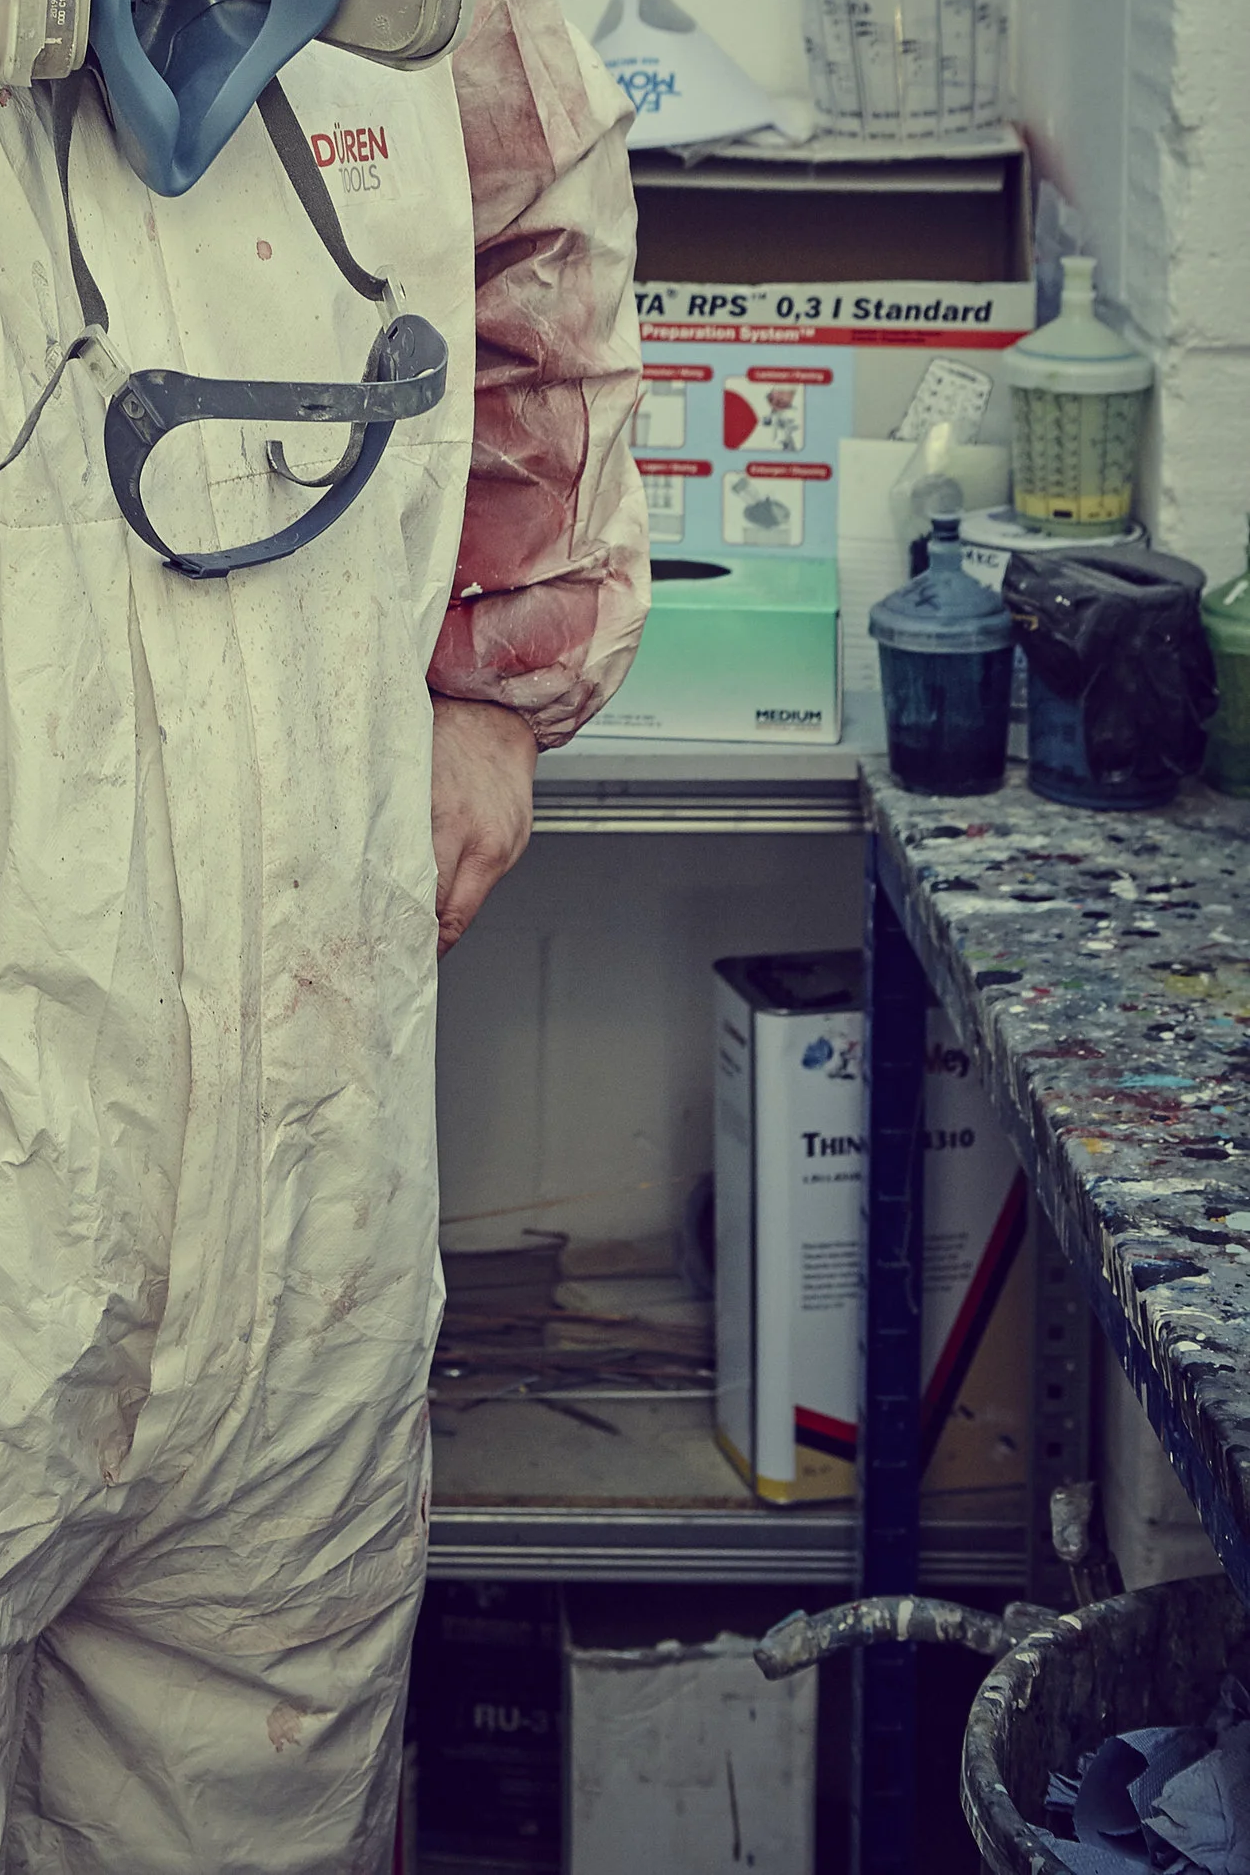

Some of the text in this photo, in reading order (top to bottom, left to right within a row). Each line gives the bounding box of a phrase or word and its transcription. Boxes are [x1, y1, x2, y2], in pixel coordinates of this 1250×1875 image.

[310, 122, 389, 168] DÜREN
[338, 164, 381, 193] TOOLS
[775, 296, 822, 324] 0,3
[852, 297, 994, 324] Standard
[641, 323, 736, 341] Preparation
[755, 709, 822, 722] MEDIUM
[801, 1131, 864, 1158] THIN
